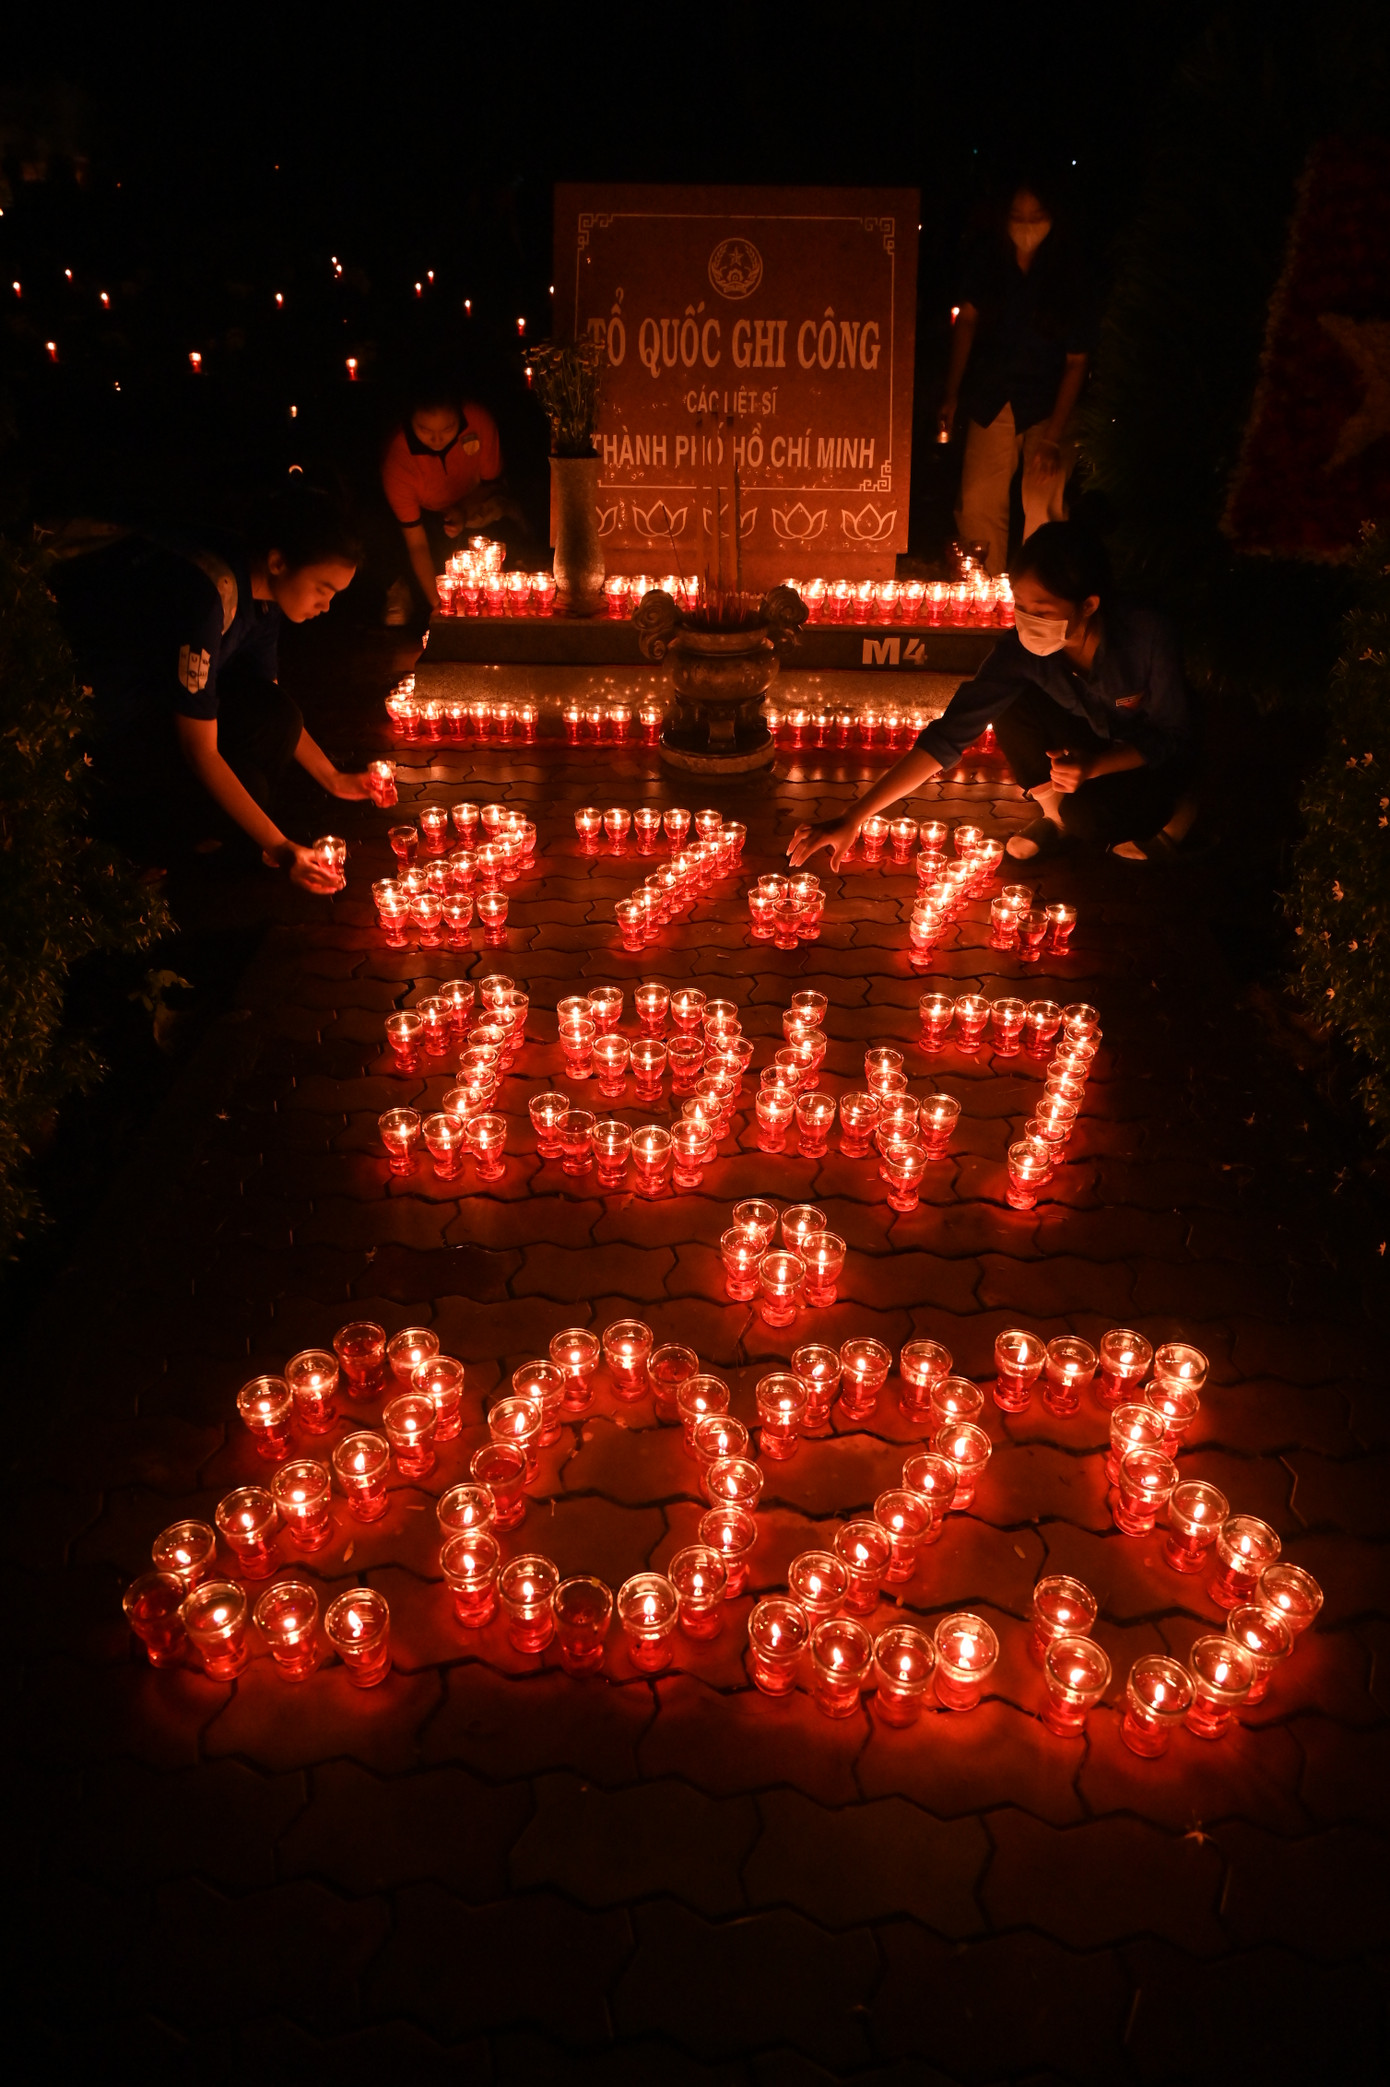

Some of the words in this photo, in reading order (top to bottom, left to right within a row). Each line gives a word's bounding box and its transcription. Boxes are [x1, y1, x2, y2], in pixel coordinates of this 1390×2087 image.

[587, 287, 626, 367] TỔ
[638, 301, 721, 378] QUỐC
[732, 319, 788, 368] GHI
[797, 306, 881, 369] CÔNG
[762, 385, 779, 415] SĨ
[733, 422, 764, 468] HỒ
[770, 428, 812, 468] CHÍ
[816, 437, 876, 469] MINH
[862, 637, 929, 666] M4
[121, 1318, 1326, 1758] 2023
